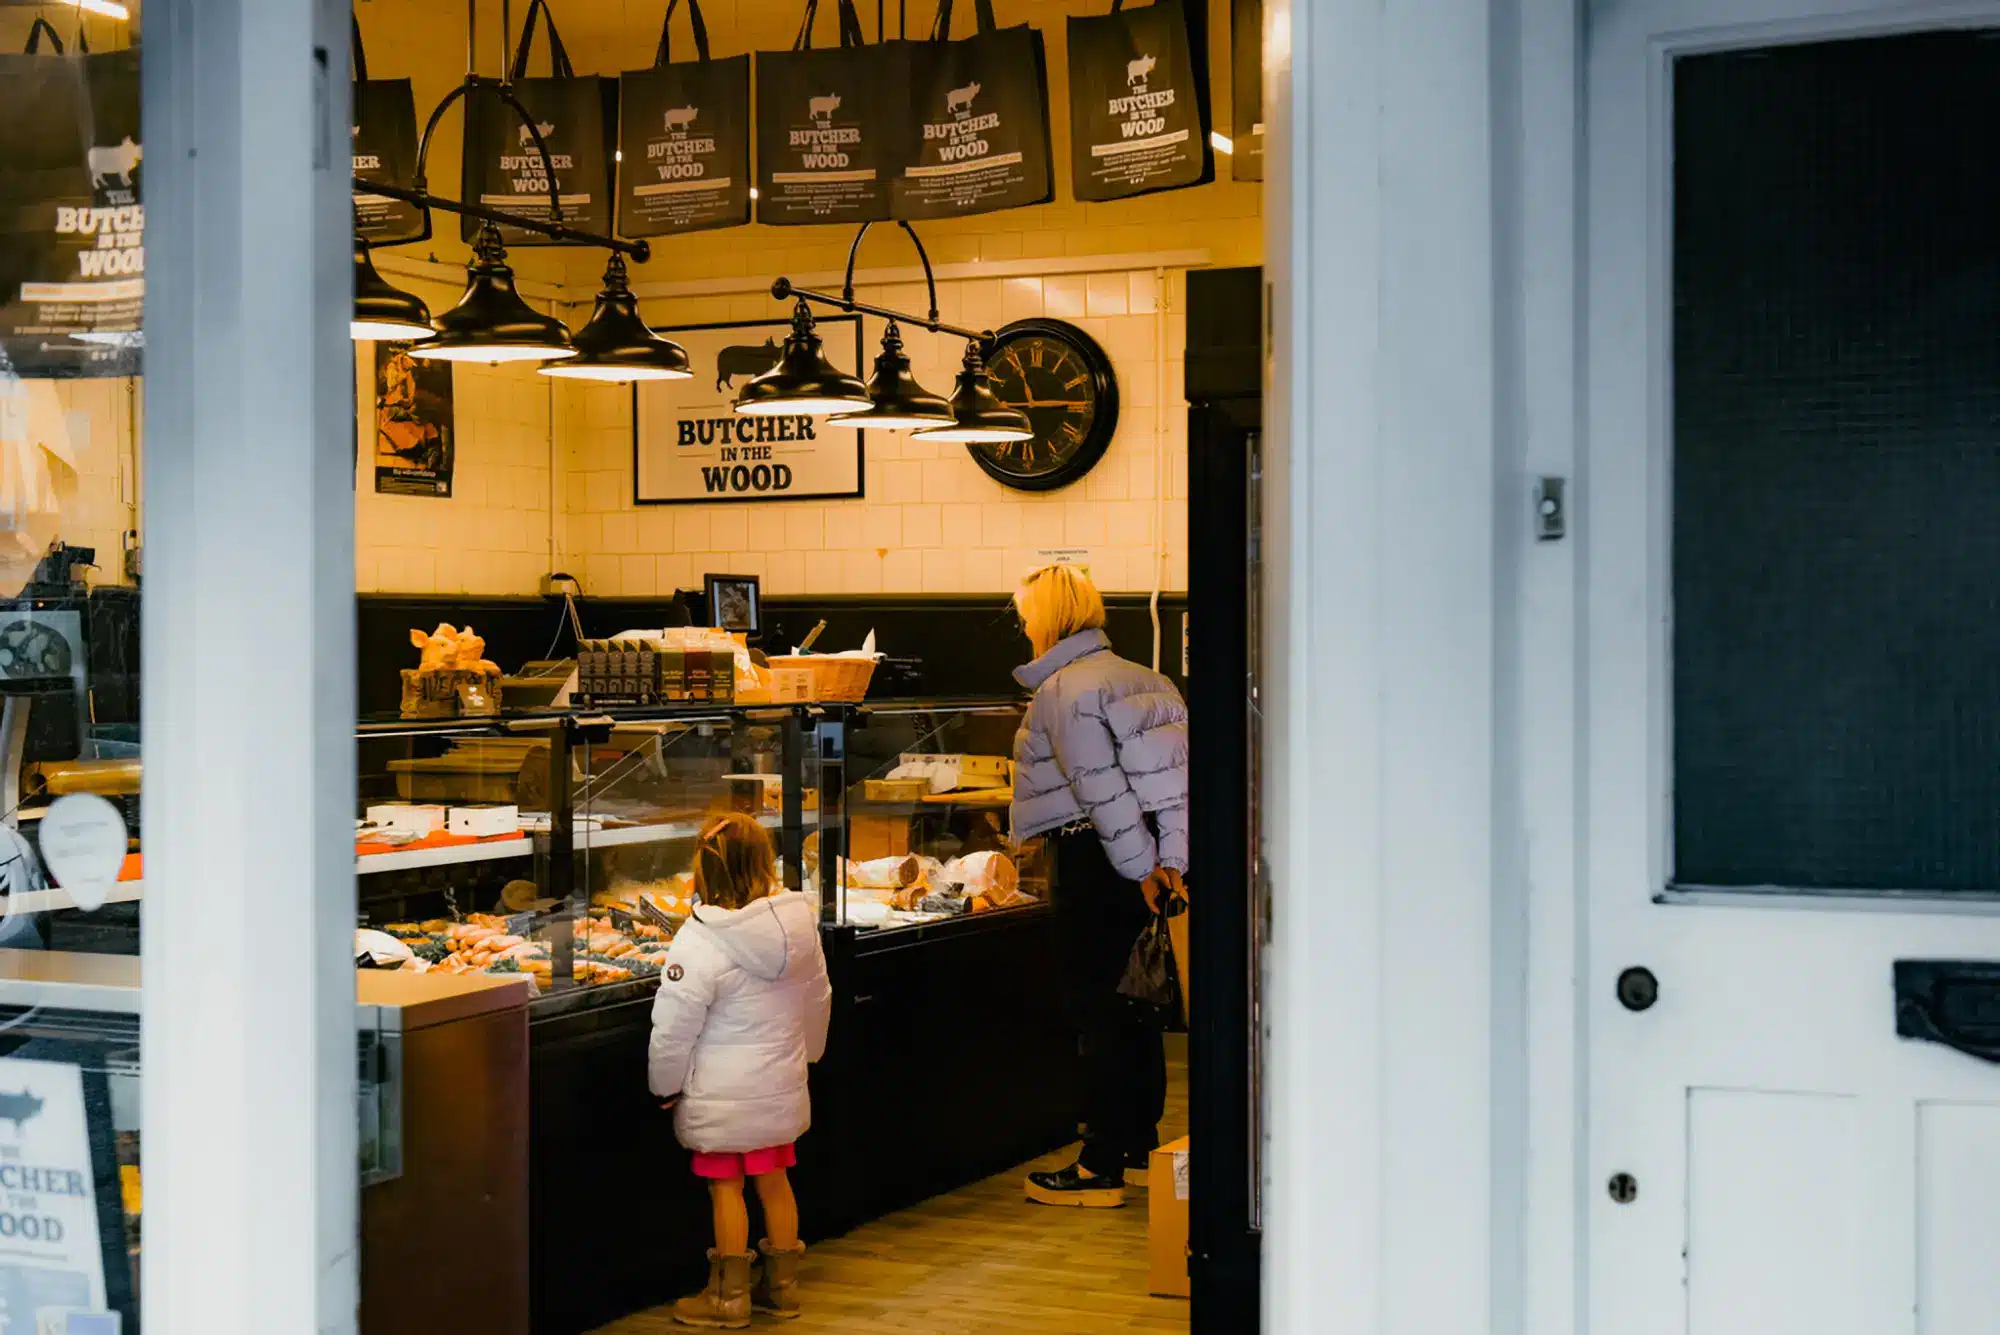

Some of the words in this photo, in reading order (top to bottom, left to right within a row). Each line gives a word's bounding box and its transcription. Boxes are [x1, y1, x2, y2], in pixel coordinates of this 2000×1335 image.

[1108, 89, 1175, 115] BUTCHER
[923, 112, 1000, 139] BUTCHER
[1121, 117, 1165, 138] WOOD
[789, 128, 861, 145] BUTCHER
[647, 139, 716, 158] BUTCHER
[938, 140, 989, 162] WOOD
[802, 153, 849, 168] WOOD
[657, 163, 704, 180] WOOD
[676, 415, 817, 446] BUTCHER
[720, 447, 737, 462] IN
[740, 446, 772, 460] THE
[702, 464, 792, 493] WOOD
